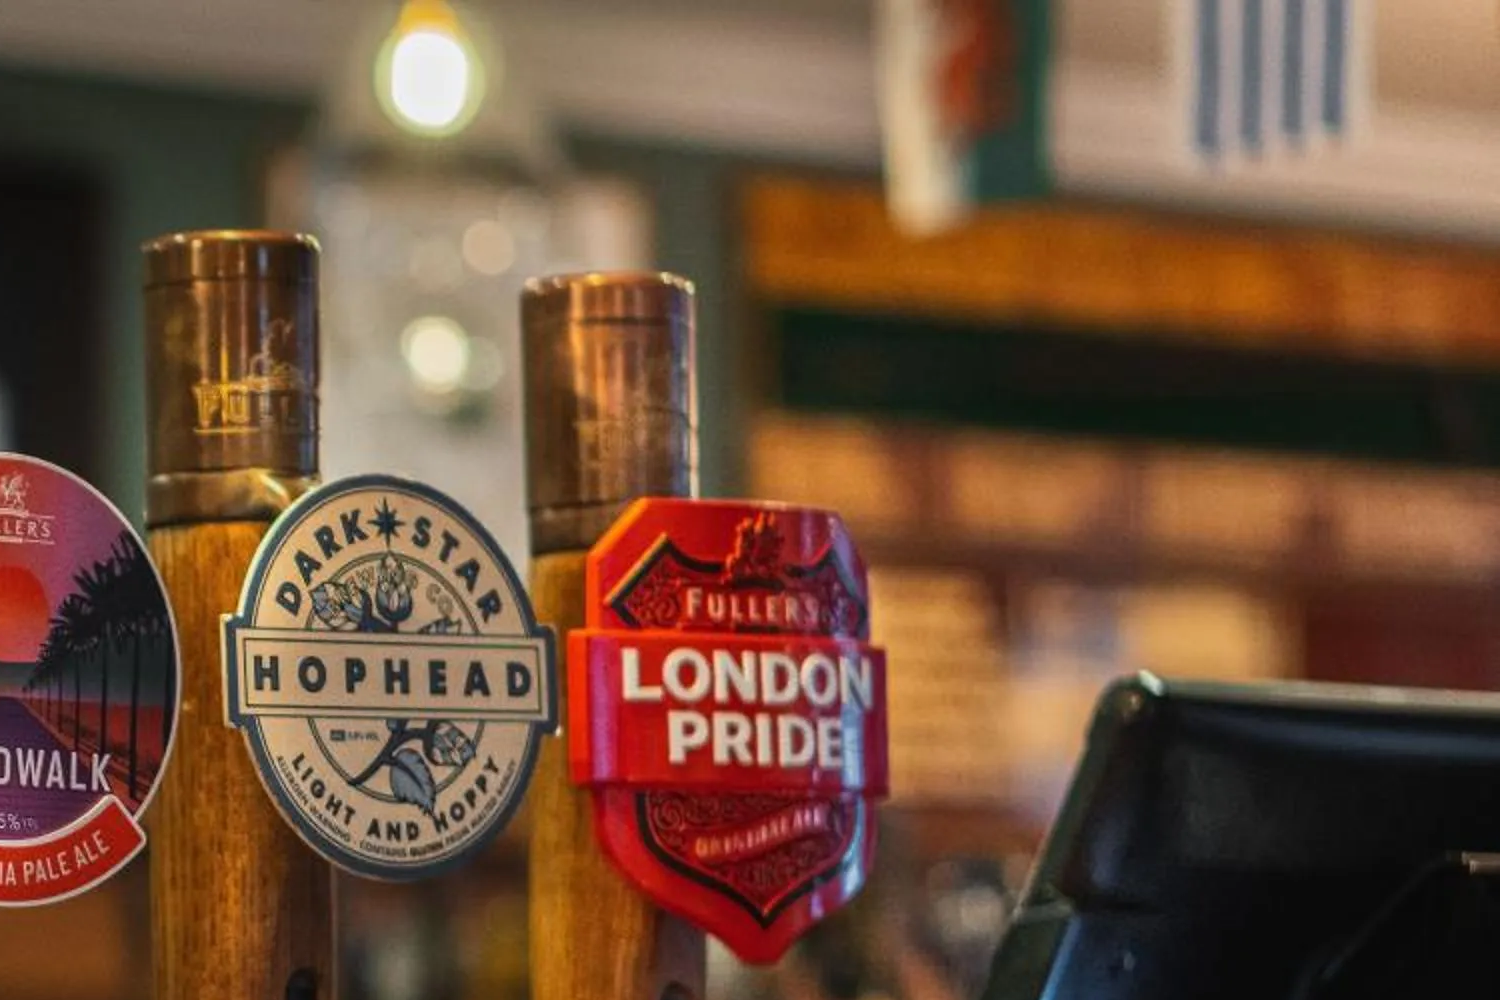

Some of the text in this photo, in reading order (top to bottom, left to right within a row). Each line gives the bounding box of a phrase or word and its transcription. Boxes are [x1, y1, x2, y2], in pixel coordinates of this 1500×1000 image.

[275, 508, 369, 617] DARK
[411, 515, 503, 624] STAR
[253, 655, 532, 698] HOPHEAD
[621, 647, 874, 708] LONDON
[667, 710, 846, 769] PRIDE
[291, 752, 356, 826] LIGHT
[366, 818, 420, 842] AND
[433, 755, 499, 834] HOPPY
[22, 851, 73, 885] PALE
[74, 829, 111, 866] ALE
